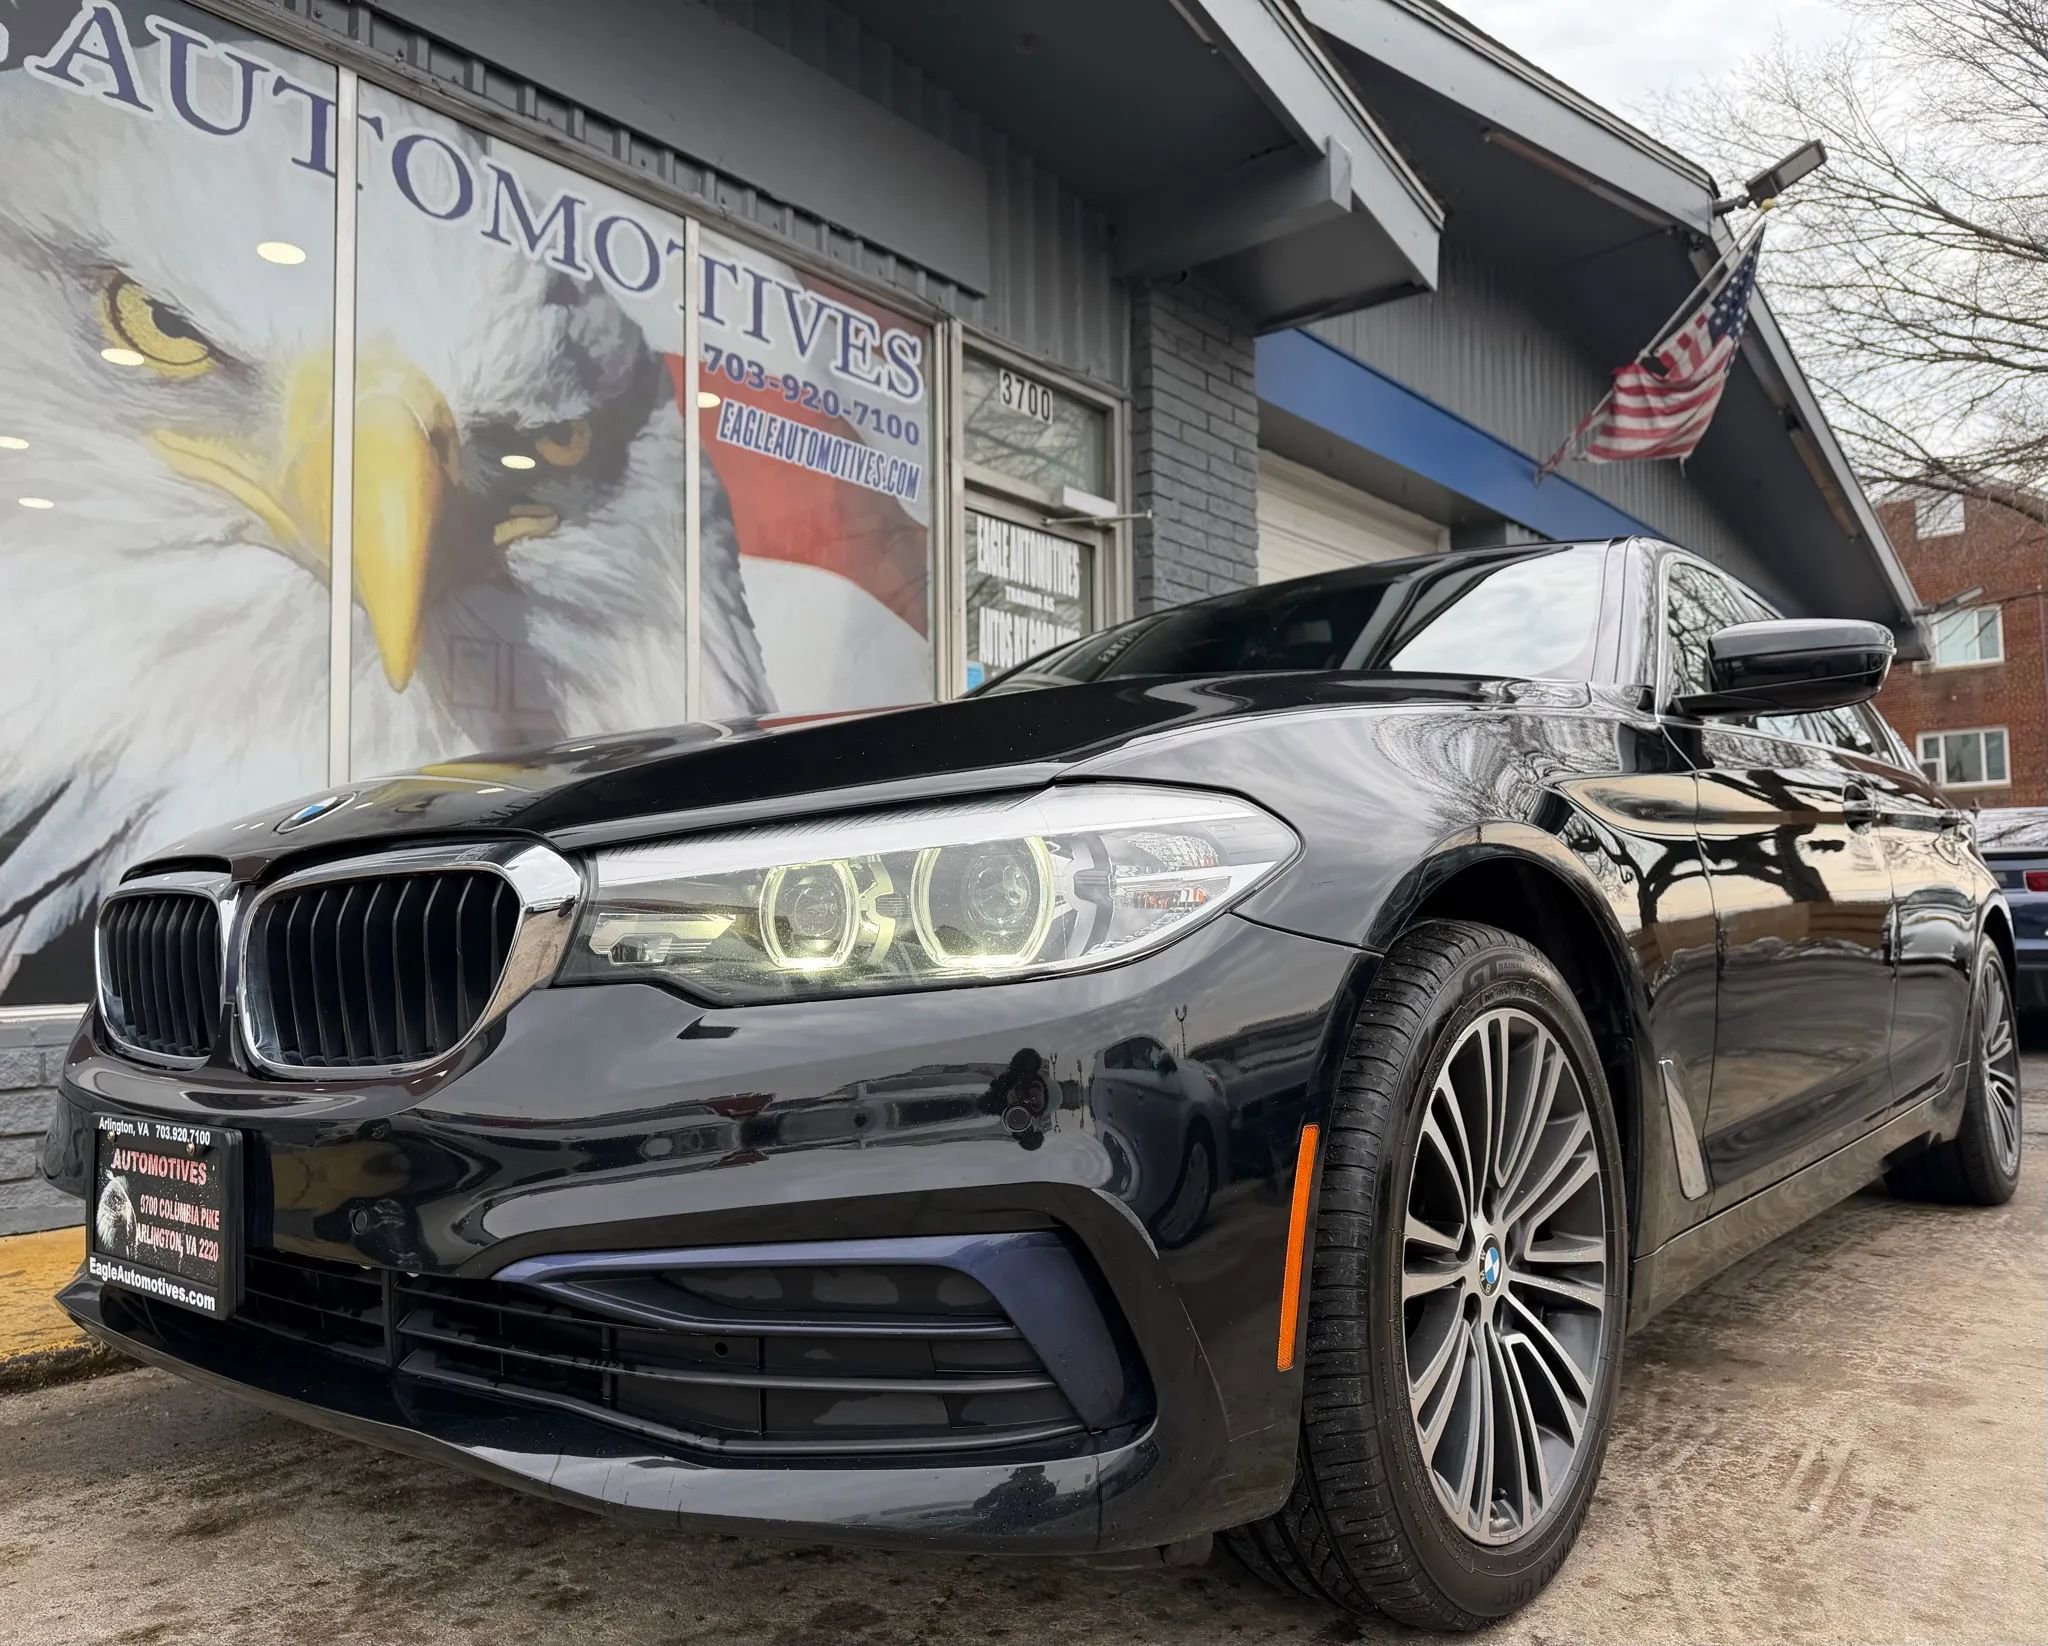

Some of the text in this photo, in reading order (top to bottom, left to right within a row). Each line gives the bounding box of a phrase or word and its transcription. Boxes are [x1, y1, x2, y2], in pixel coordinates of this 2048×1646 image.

[28, 2, 922, 401] AUTOMOTIVES
[703, 342, 920, 446] 703-920-7100
[1002, 371, 1050, 422] 3700
[717, 400, 921, 501] EAGLEAUTOMOTIVES.COM
[977, 515, 1009, 580] EAGLE
[99, 1117, 211, 1146] Arlington, VA 703.920.7100
[111, 1148, 207, 1186] AUTOMOTIVES
[140, 1194, 220, 1231] 3700 COLUMBIA PIKE
[135, 1222, 219, 1263] ARLINGTON, VA 2220
[89, 1256, 216, 1312] EagleAutomotives.com
